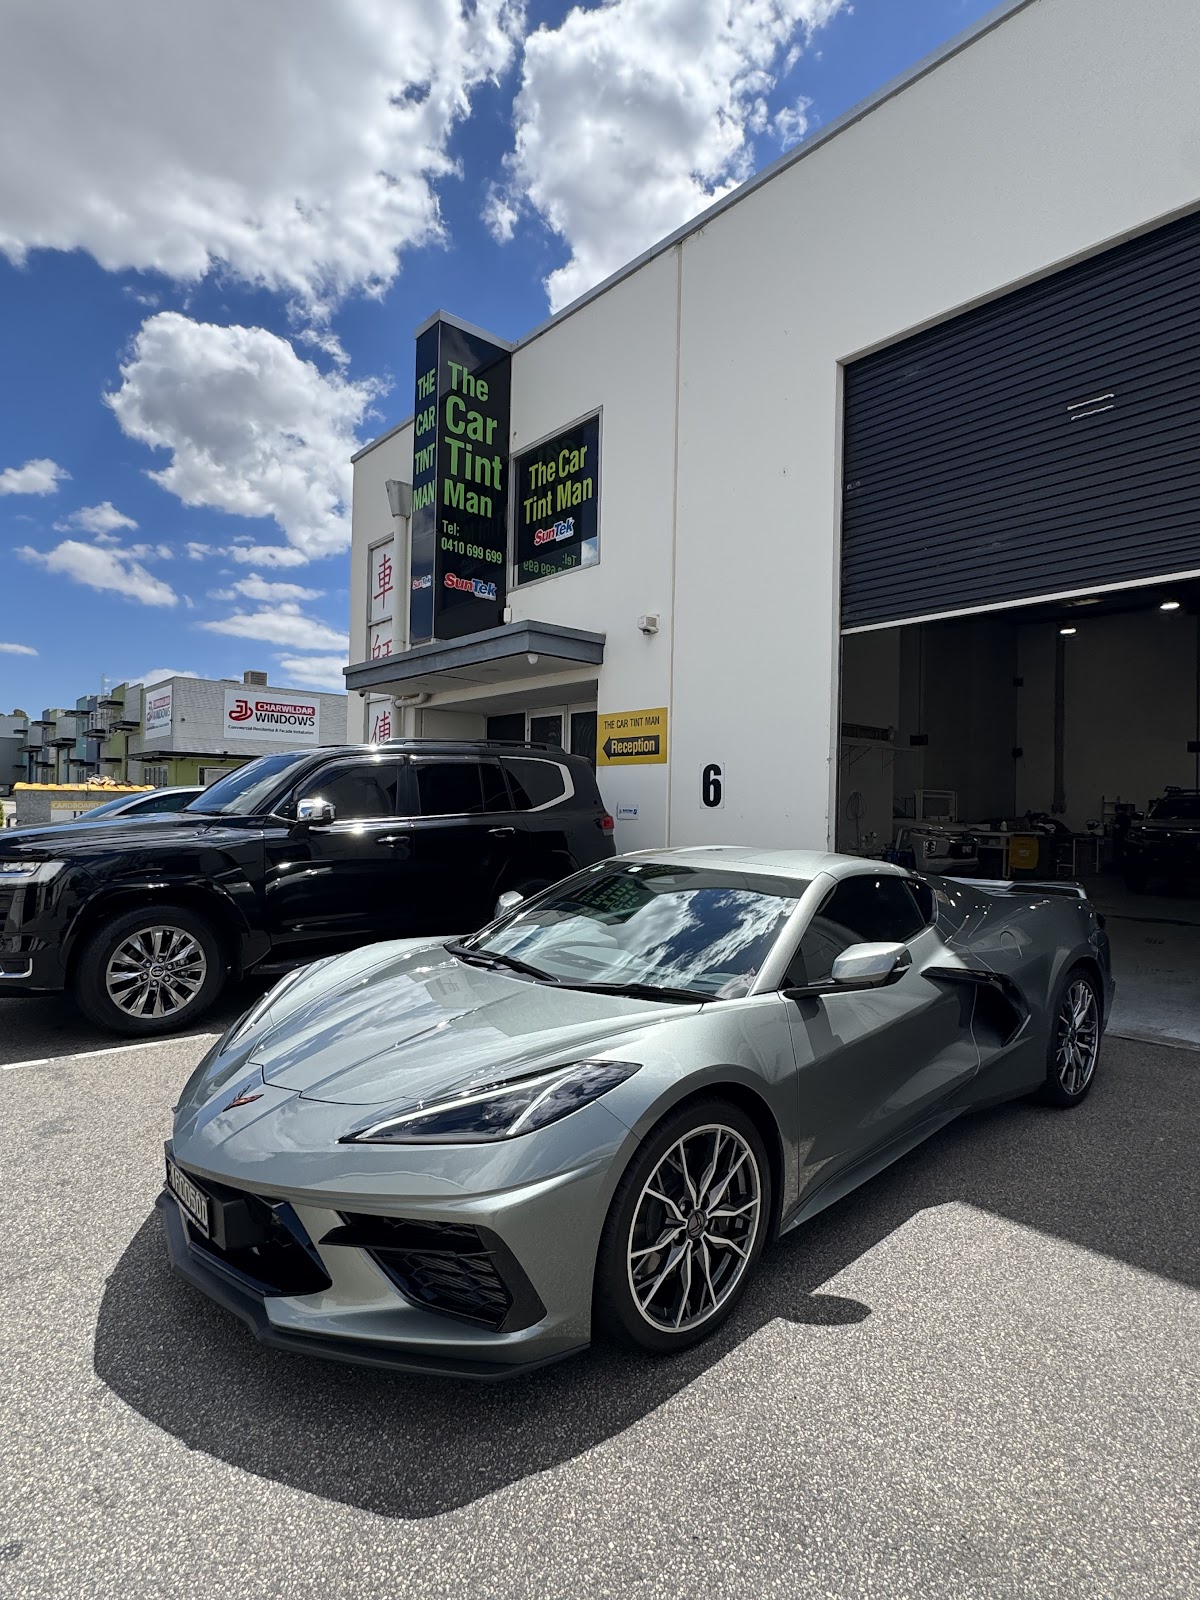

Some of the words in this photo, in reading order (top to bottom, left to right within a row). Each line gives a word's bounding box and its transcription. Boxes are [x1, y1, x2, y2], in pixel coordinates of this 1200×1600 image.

[417, 368, 436, 401] THE
[447, 360, 489, 402] The
[415, 405, 436, 437] CAR
[445, 395, 498, 446] Car
[414, 443, 436, 475] TINT
[444, 436, 503, 491] Tint
[528, 461, 556, 490] The
[558, 445, 588, 478] Car
[412, 480, 435, 512] MAN
[443, 478, 492, 518] Man
[523, 490, 553, 525] Tint
[556, 477, 593, 512] Man
[442, 520, 460, 537] Tel:
[534, 517, 574, 545] SunTek
[441, 537, 465, 555] 0410
[466, 544, 484, 560] 699
[485, 549, 503, 565] 699
[444, 573, 497, 597] SunTek
[255, 712, 315, 726] WINDOWS
[257, 703, 314, 715] CHARWILDAR
[604, 720, 615, 730] THE
[616, 718, 629, 729] CAR
[630, 717, 643, 727] TINT
[644, 715, 660, 726] MAN
[611, 738, 656, 755] Reception
[702, 763, 722, 808] 6
